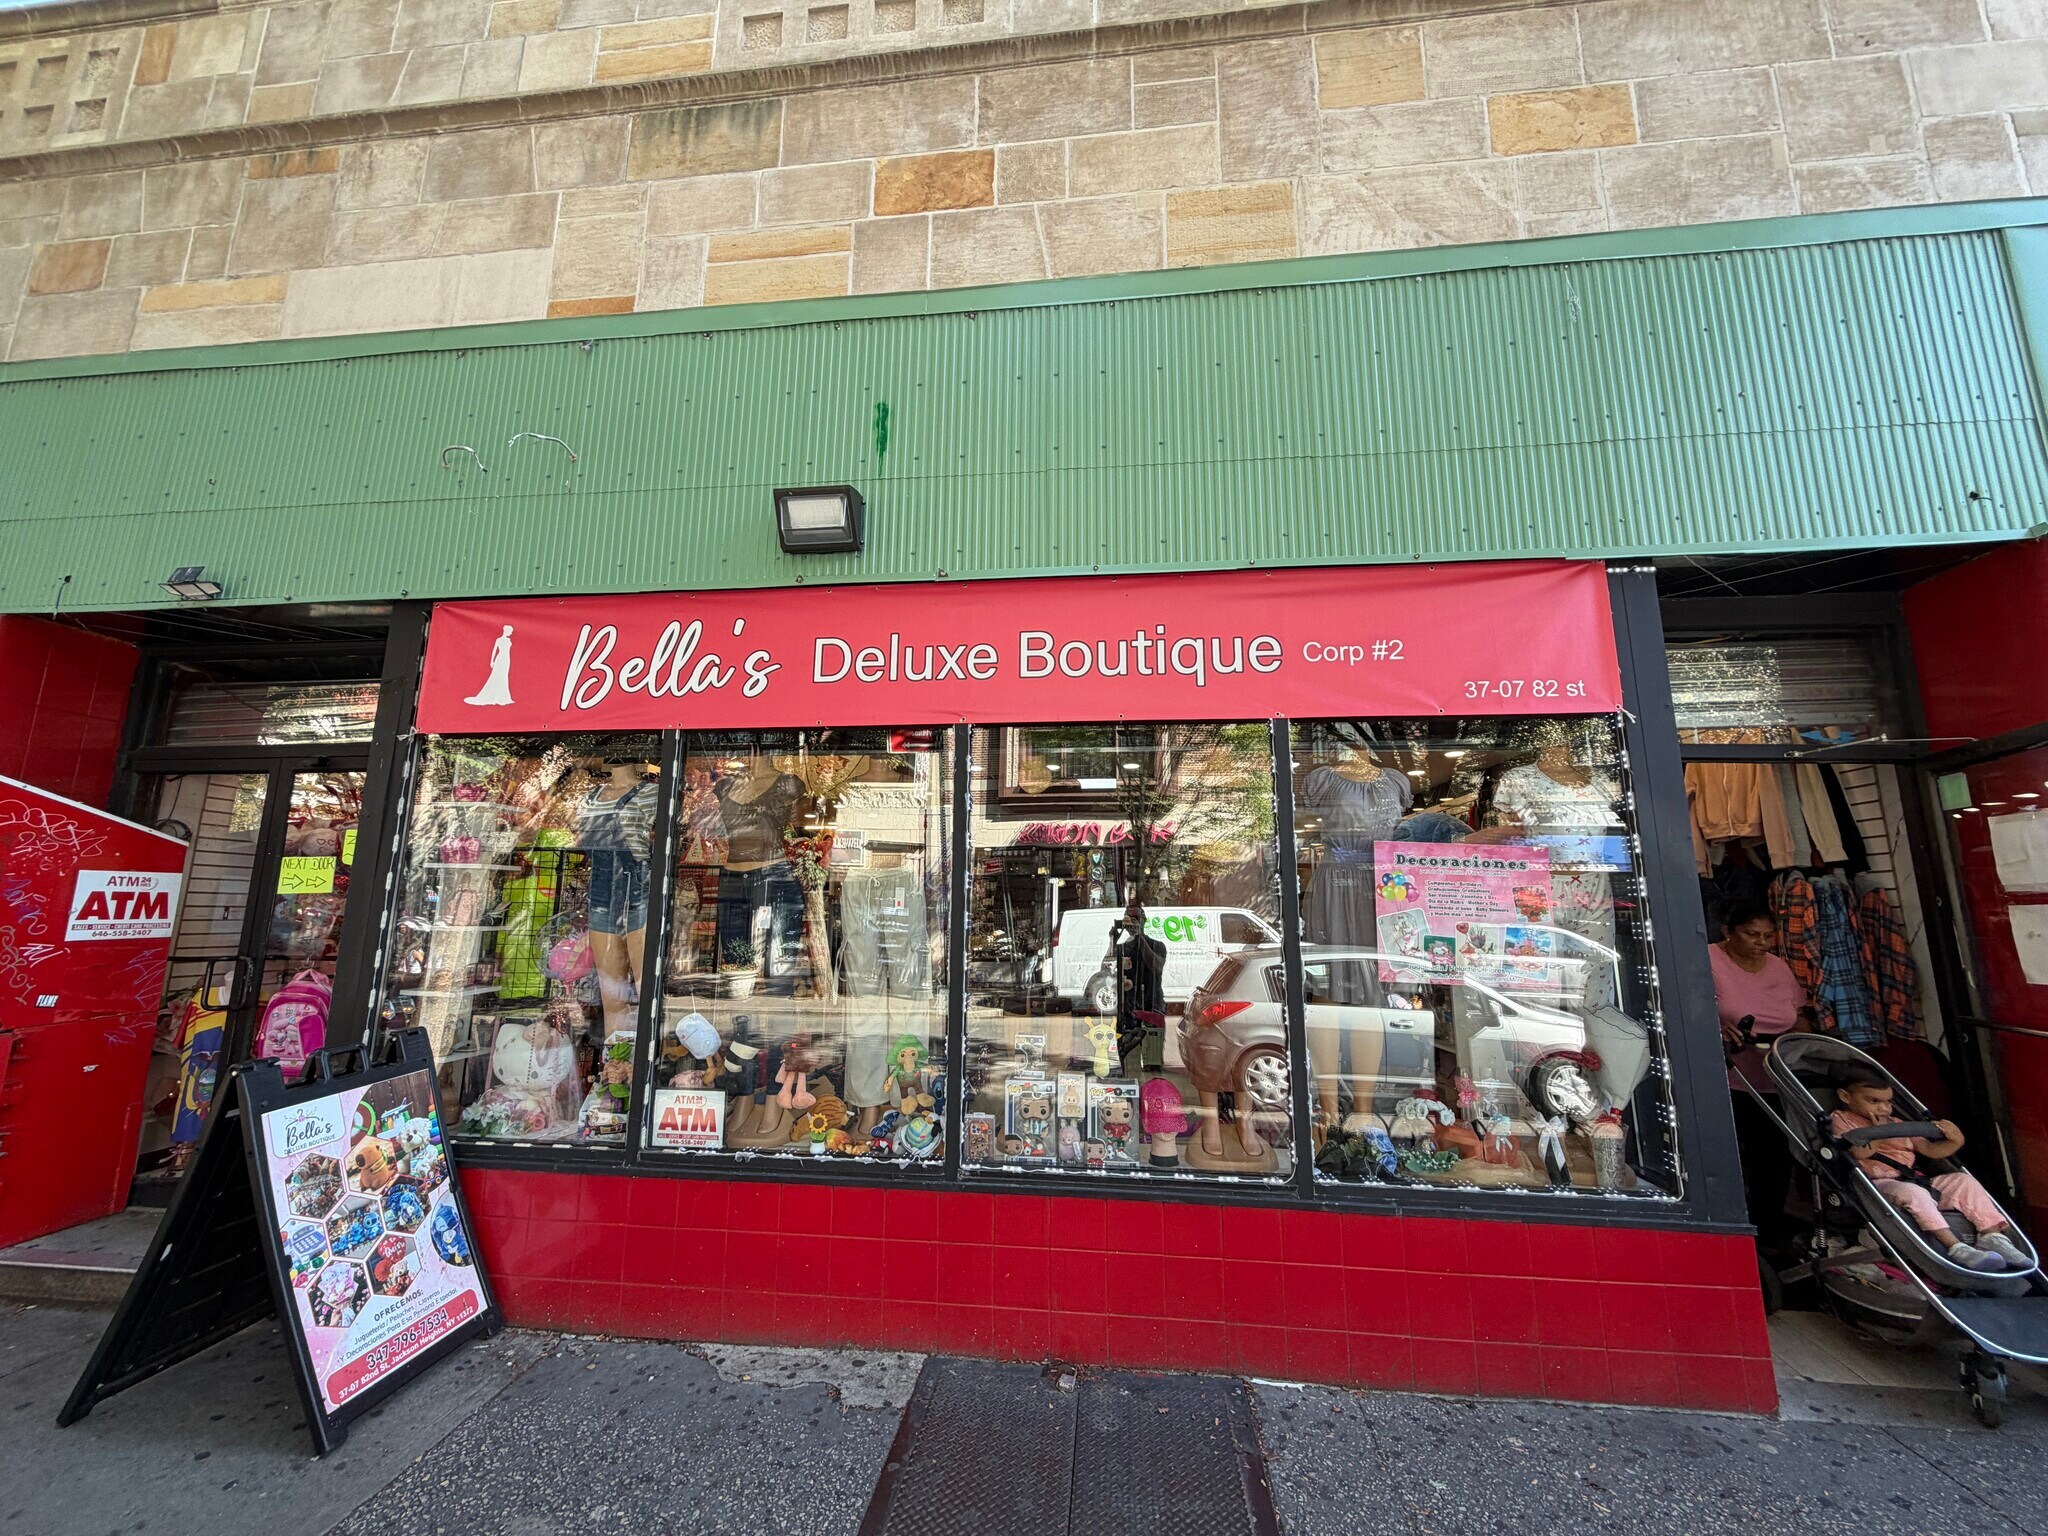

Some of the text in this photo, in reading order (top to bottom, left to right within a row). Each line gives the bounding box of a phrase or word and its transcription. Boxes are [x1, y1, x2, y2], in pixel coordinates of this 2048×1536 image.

[560, 618, 1405, 712] Bella's Deluxe Boutique Corp #2
[1464, 678, 1587, 699] 37-07 82 st
[282, 857, 335, 870] NEXT DOOR
[1395, 853, 1529, 870] Decoraciones
[106, 875, 140, 887] ATM
[75, 891, 169, 920] ATM
[674, 1095, 694, 1104] ATM
[287, 1117, 333, 1148] Bella's
[658, 1107, 717, 1132] ATM
[309, 1134, 336, 1147] BOUTIQUE
[374, 1288, 424, 1322] OFRECEMOS:
[390, 1305, 415, 1325] Peluches
[418, 1290, 441, 1306] Llaveros
[346, 1330, 386, 1359] Decoraciones
[387, 1321, 400, 1334] Para
[413, 1302, 435, 1318] Persona
[366, 1308, 449, 1370] 347-796-7534
[338, 1379, 360, 1399] 37-07
[361, 1368, 379, 1385] 82nd
[391, 1343, 420, 1365] Jackson
[446, 1318, 456, 1328] NY
[456, 1305, 474, 1320] 11372
